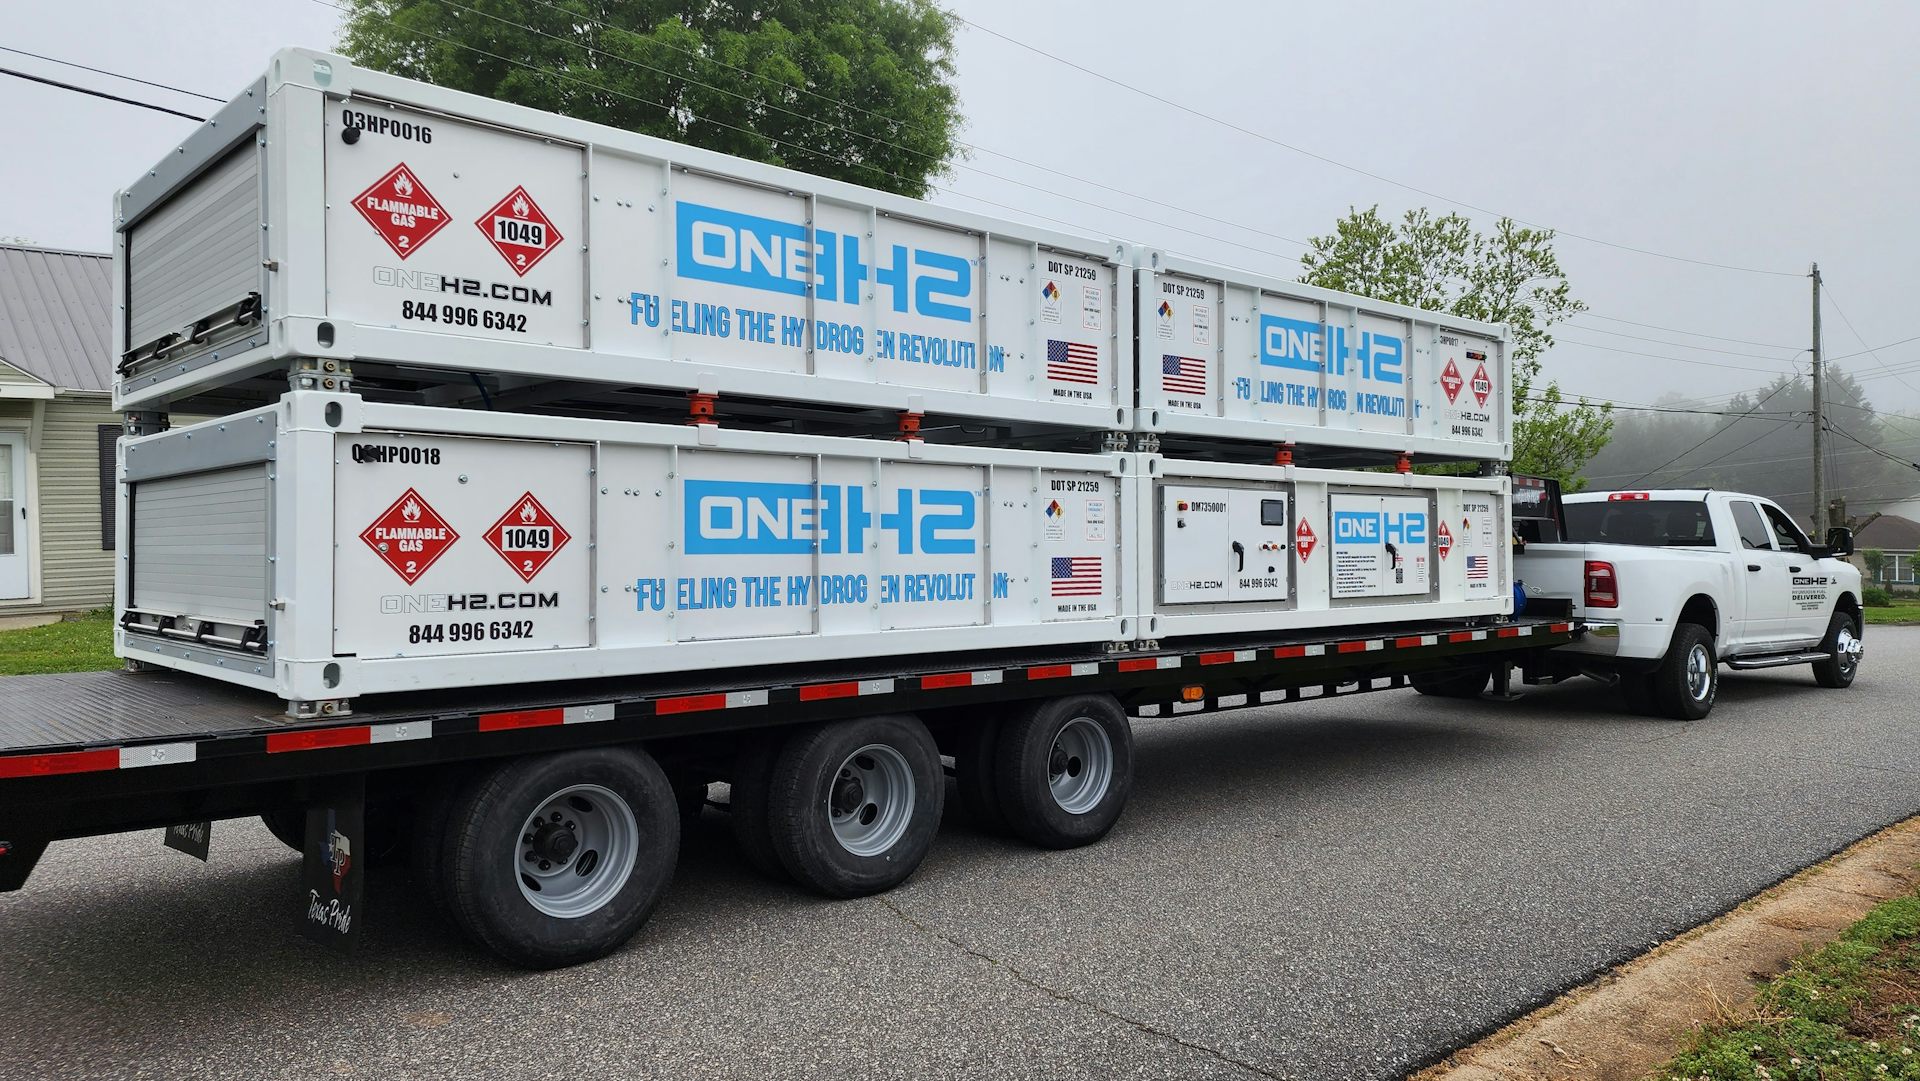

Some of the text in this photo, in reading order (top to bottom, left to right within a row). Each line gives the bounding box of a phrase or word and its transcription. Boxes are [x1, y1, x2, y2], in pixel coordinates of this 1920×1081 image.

[367, 196, 438, 220] FLAMMABLE
[390, 214, 416, 228] GAS
[498, 220, 542, 245] 1049
[398, 235, 409, 248] 2
[516, 254, 526, 266] 2
[1048, 261, 1097, 281] DOT SP 21259
[1163, 282, 1205, 300] DOT SP 21259
[402, 300, 527, 333] 844 996 6342
[630, 292, 731, 339] FUELING
[735, 309, 776, 344] THE
[1475, 381, 1487, 392] 1049
[1053, 388, 1092, 400] MADE IN THE USA
[1286, 383, 1305, 407] THE
[1452, 425, 1483, 437] 844 996 6342
[352, 443, 441, 465] QHP0018
[1051, 480, 1099, 493] DOT SP 21259
[1191, 501, 1227, 513] DM7350001
[375, 527, 446, 540] FLAMMABLE
[505, 528, 550, 549] 1049
[398, 540, 423, 552] GAS
[406, 561, 417, 573] 2
[523, 560, 533, 571] 2
[1239, 578, 1278, 589] 844 996 6342
[637, 577, 737, 612] FUELING
[742, 576, 782, 608] THE
[1058, 603, 1097, 612] MADE IN THE USA
[409, 620, 534, 644] 844 996 6342
[308, 888, 351, 934] Texas Pride
